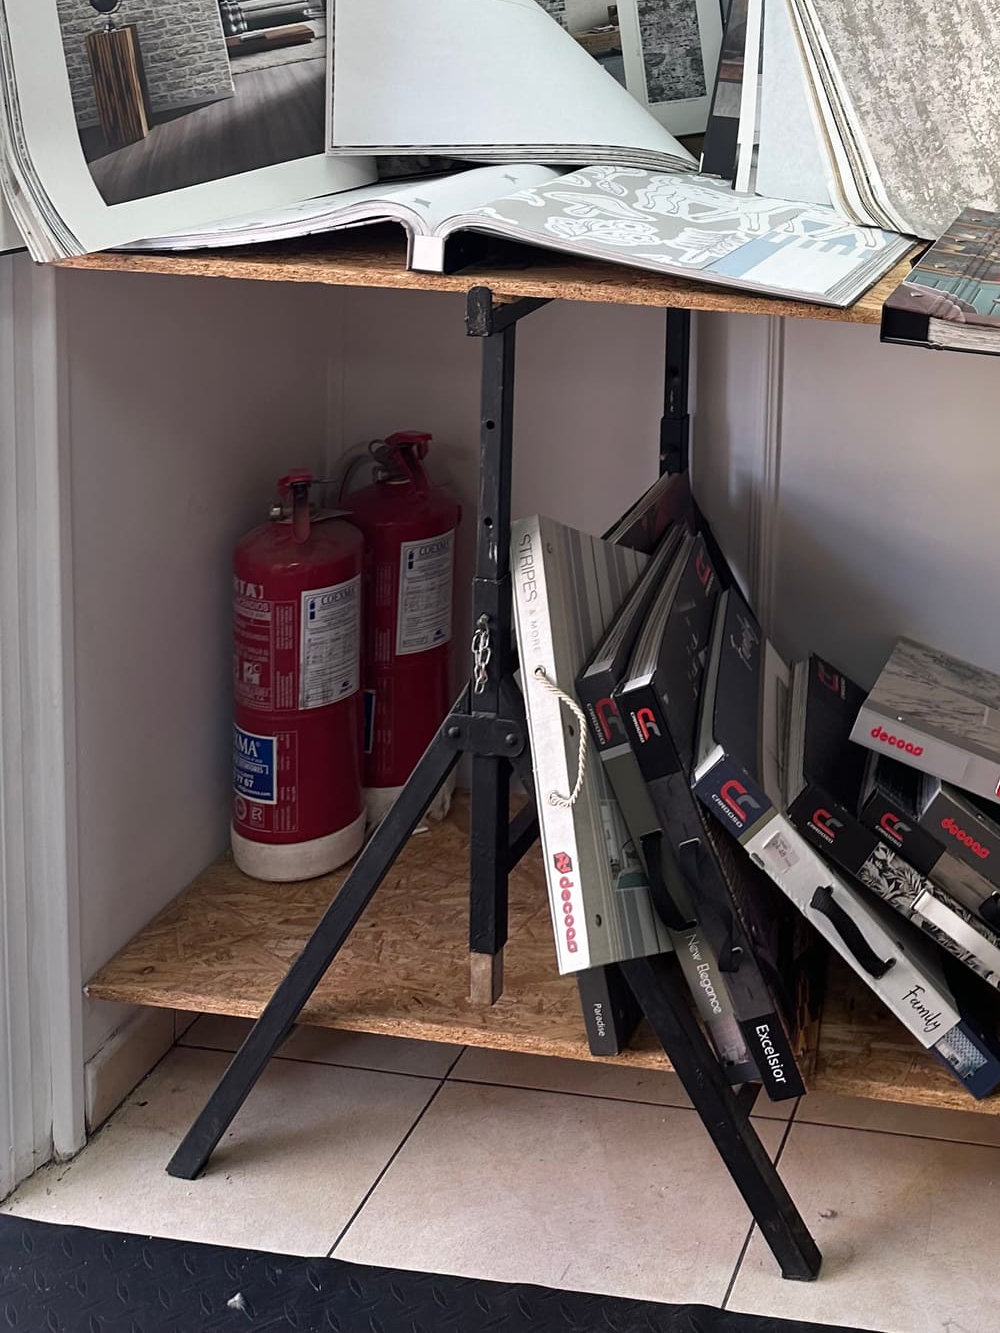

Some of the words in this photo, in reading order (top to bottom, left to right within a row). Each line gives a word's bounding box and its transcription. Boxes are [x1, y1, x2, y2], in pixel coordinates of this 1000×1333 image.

[519, 533, 538, 603] STRIPES
[711, 793, 744, 829] CARDOSO
[685, 933, 702, 961] New
[696, 963, 723, 1014] Elegance
[593, 1003, 606, 1037] Paradise
[901, 984, 942, 1033] Family
[754, 1023, 788, 1084] Excelsior
